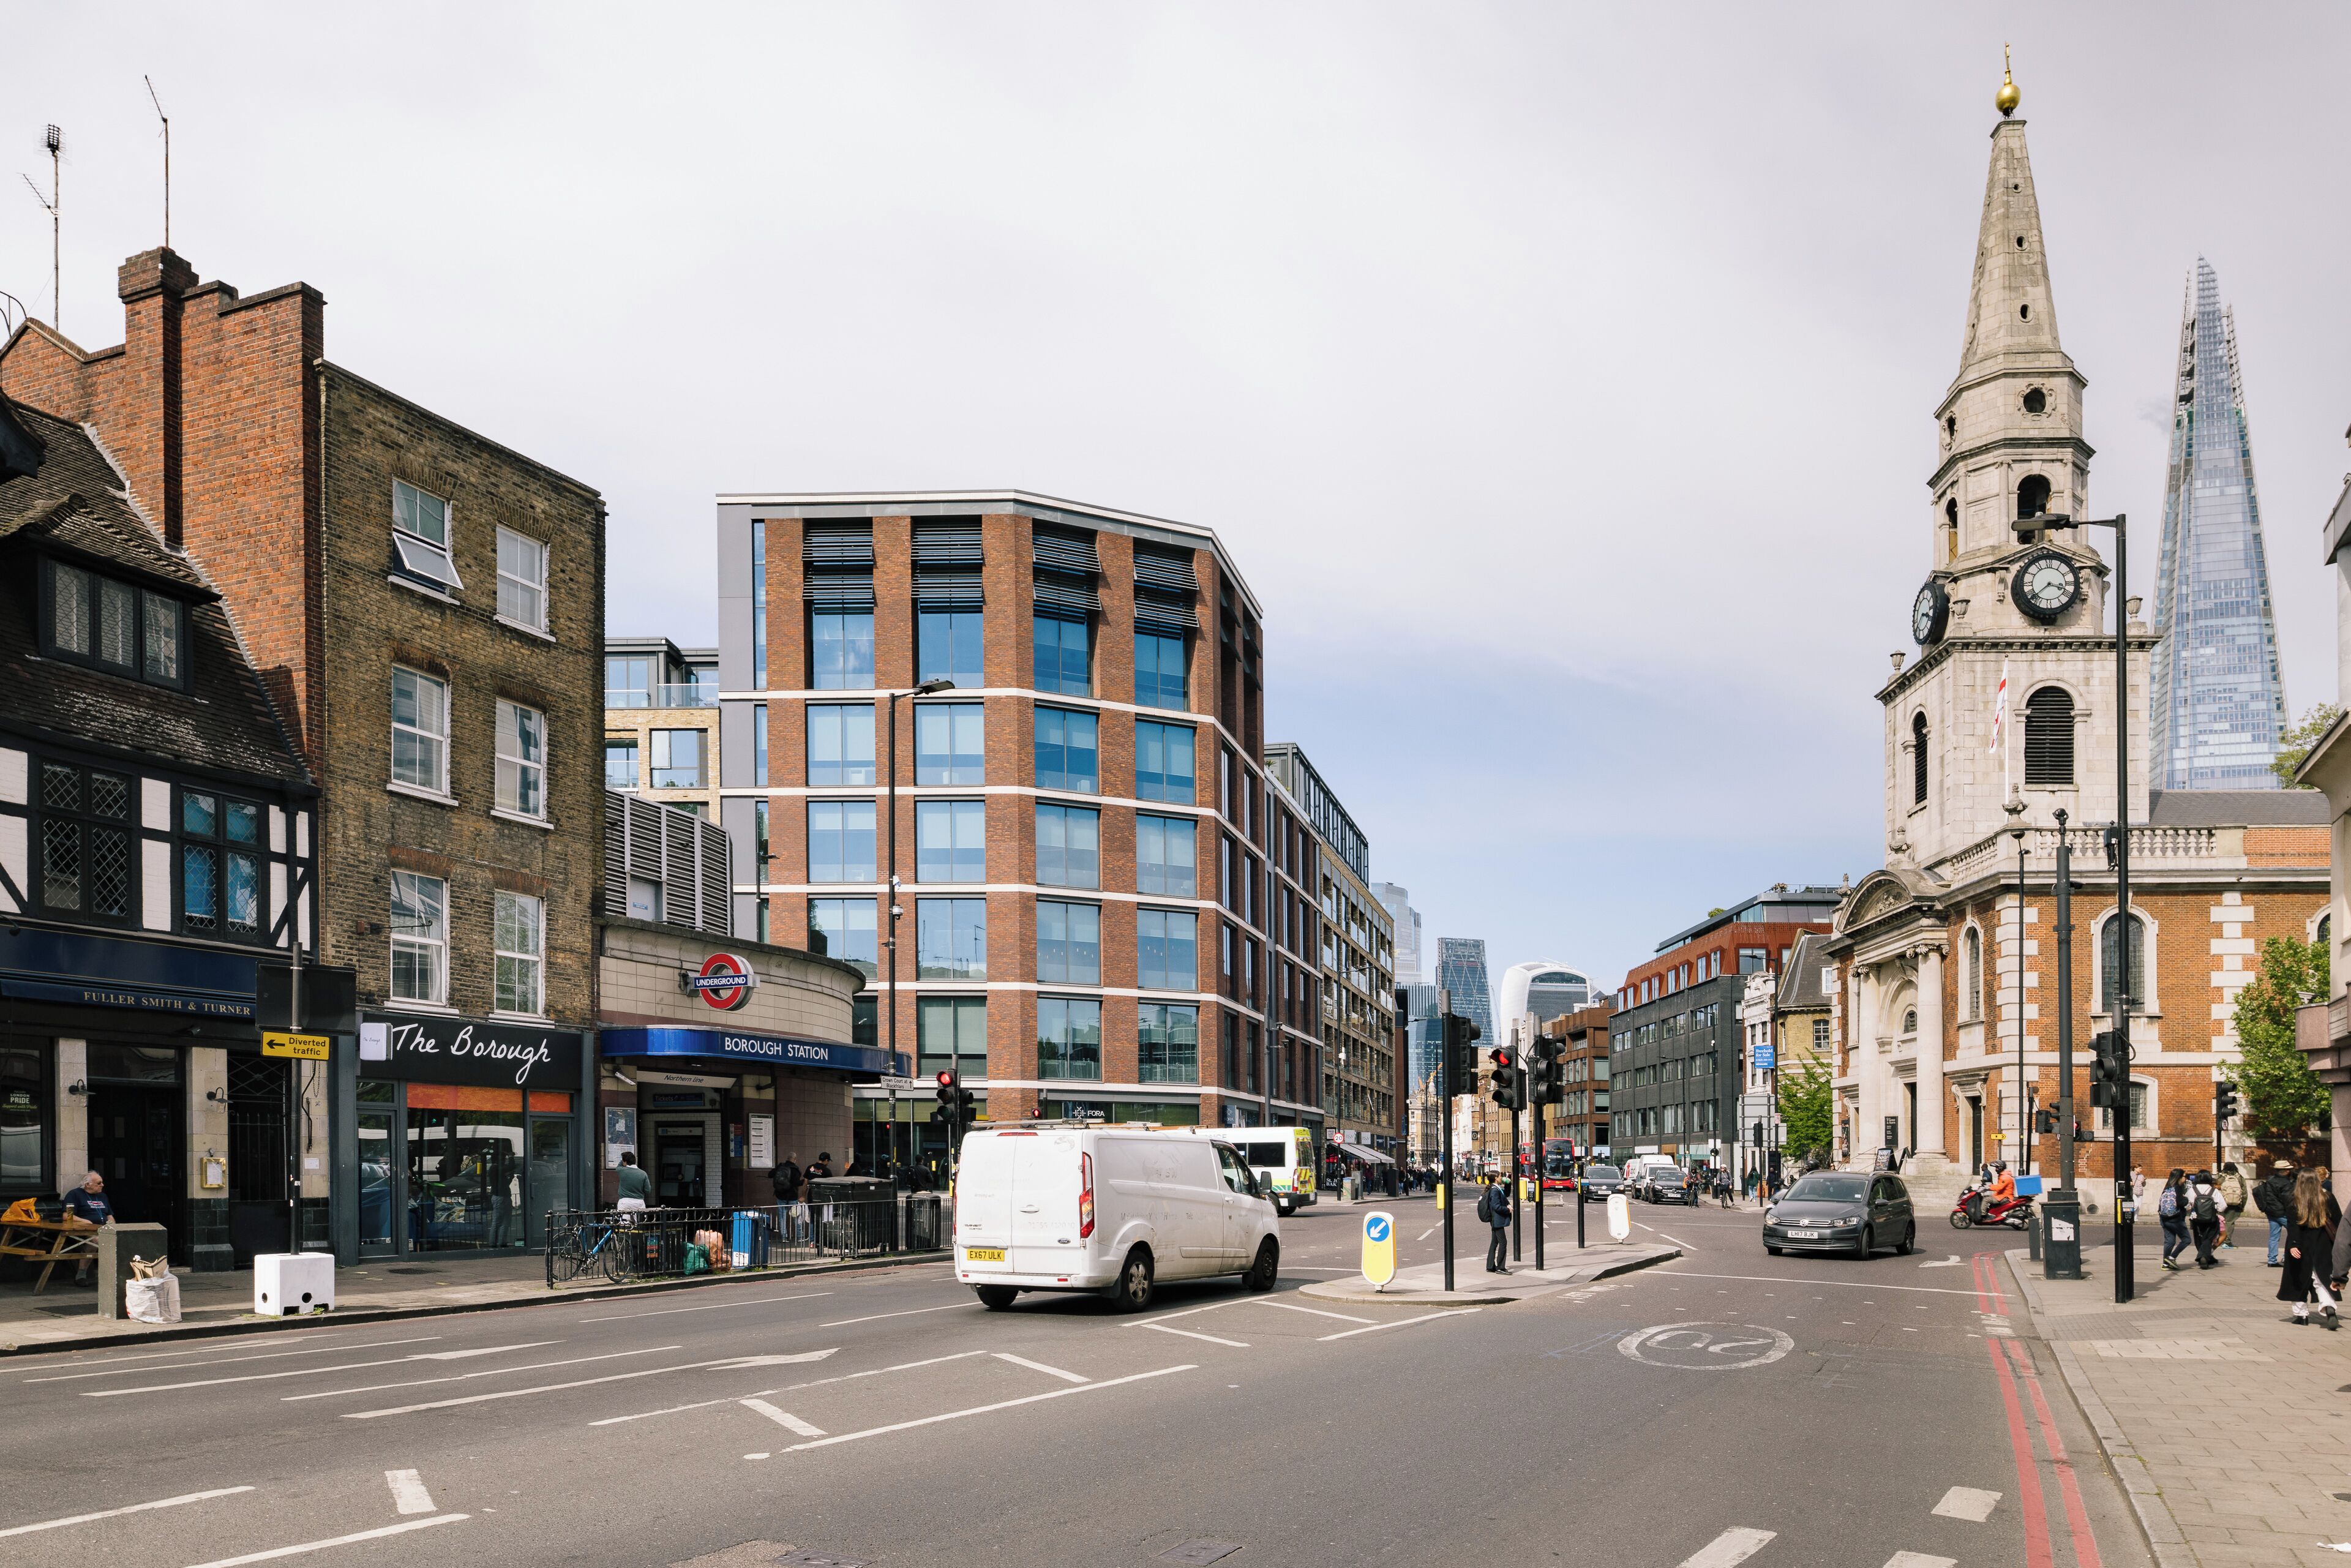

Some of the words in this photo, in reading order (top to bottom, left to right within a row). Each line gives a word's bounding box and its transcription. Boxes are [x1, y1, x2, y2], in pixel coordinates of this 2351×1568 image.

[696, 977, 746, 986] UNDERGROUND
[84, 991, 135, 1005] FULLER
[141, 997, 182, 1009] SMITH
[188, 1001, 197, 1010] &
[203, 1003, 250, 1015] TURNER
[289, 1037, 326, 1047] Diverted
[293, 1047, 321, 1056] traffic
[392, 1023, 440, 1052] The
[451, 1025, 550, 1084] Borough
[725, 1037, 782, 1056] BOROUGH
[787, 1044, 828, 1060] STATION
[969, 1250, 987, 1259] EX67
[988, 1251, 1002, 1259] ULK
